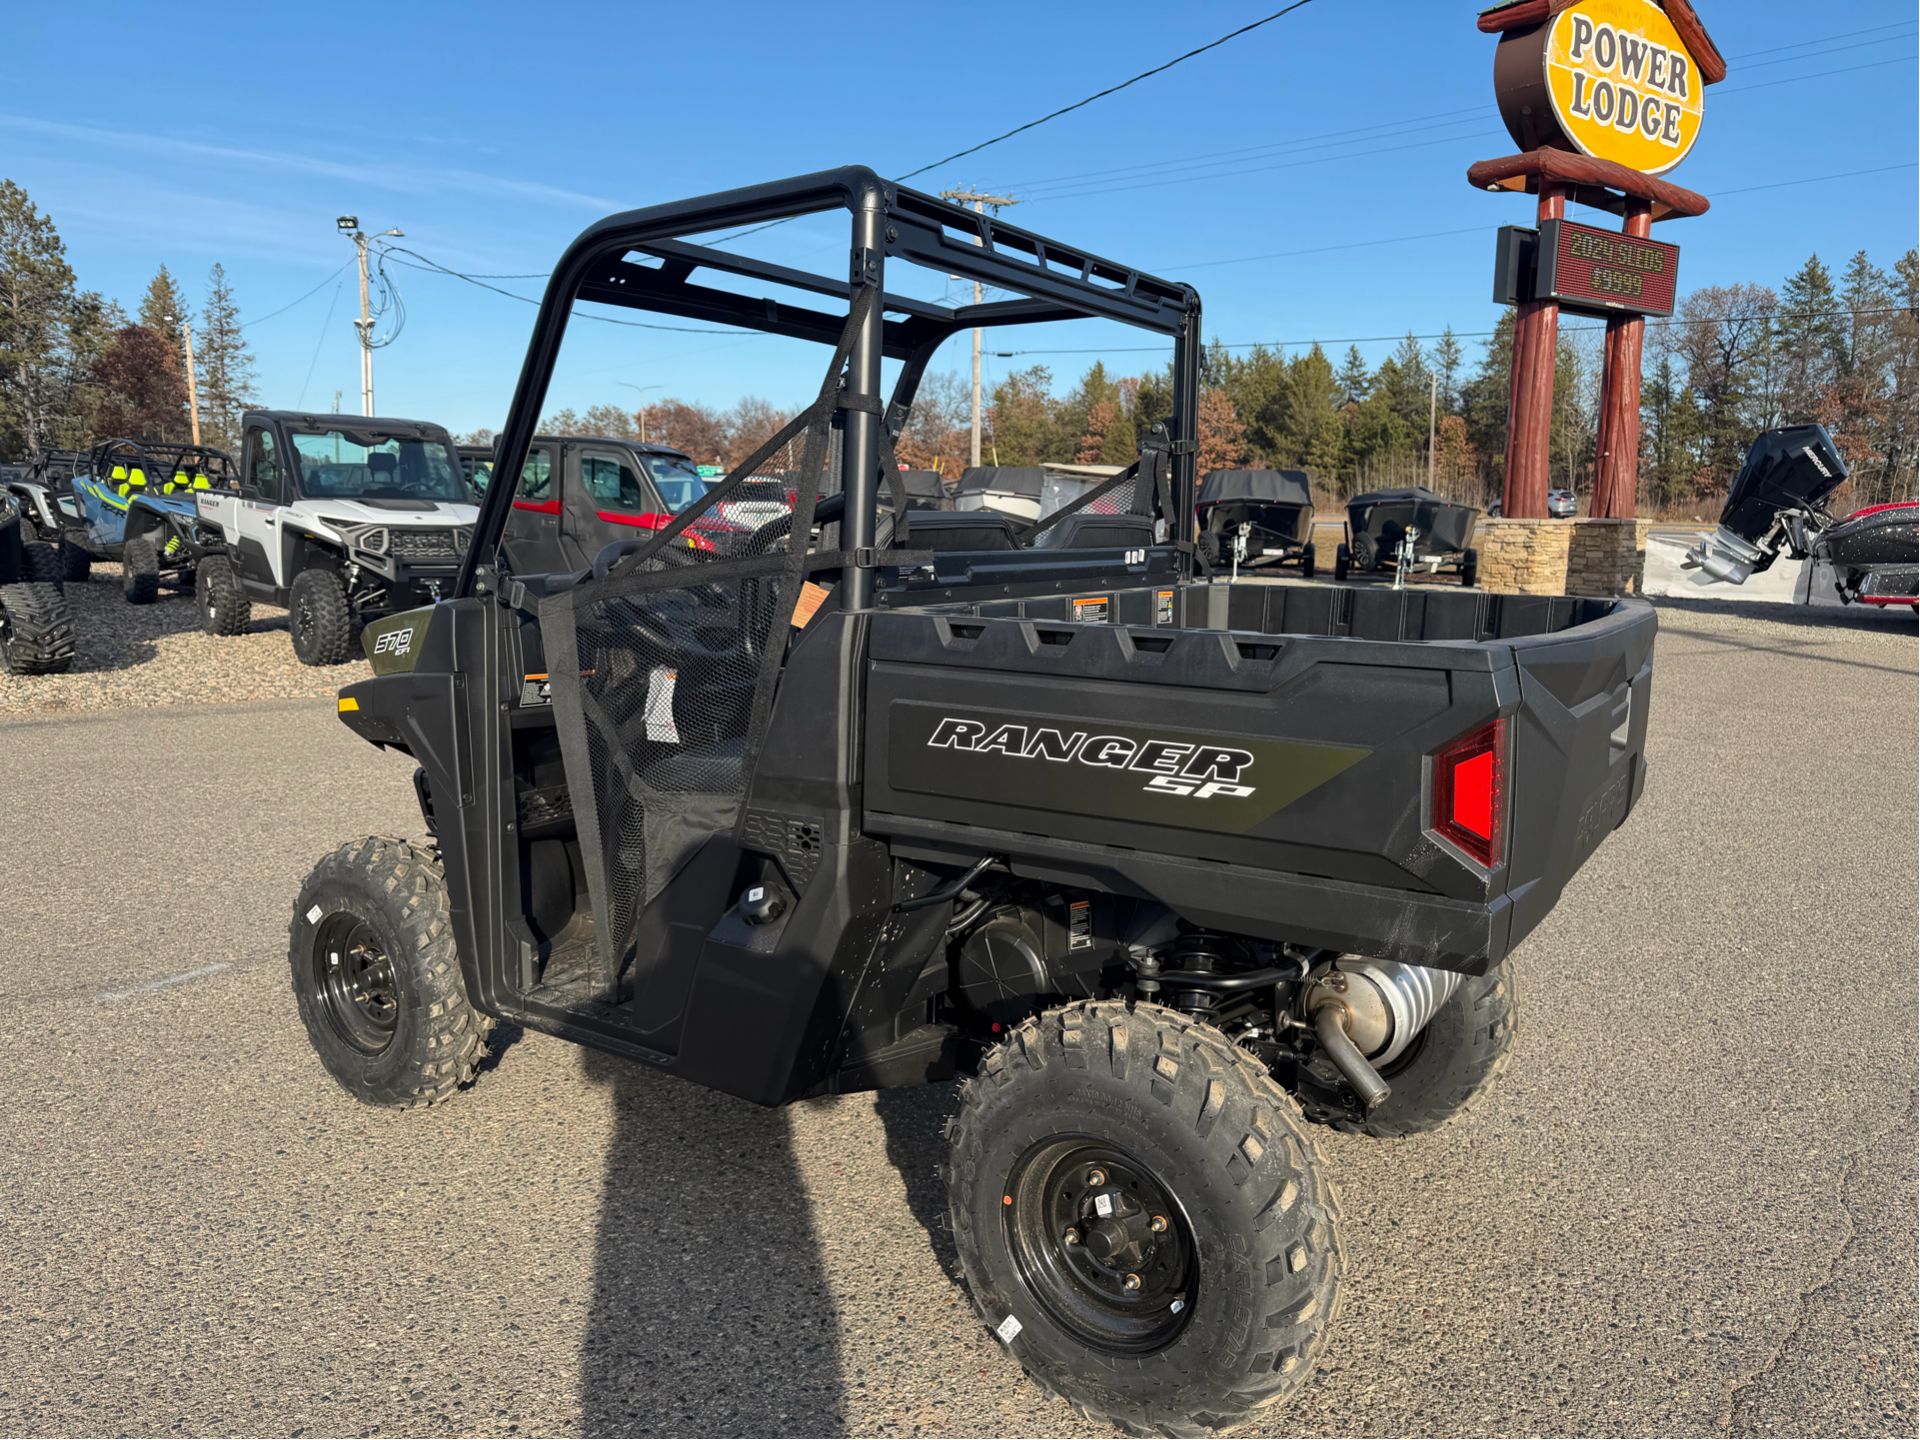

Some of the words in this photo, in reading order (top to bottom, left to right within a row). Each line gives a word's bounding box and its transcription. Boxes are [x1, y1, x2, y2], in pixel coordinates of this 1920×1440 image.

[1571, 16, 1688, 99] POWER
[1570, 71, 1682, 145] LODGE
[1570, 232, 1614, 262] 2024
[1618, 242, 1665, 273] SLEDS
[1591, 266, 1642, 296] $9999
[1802, 446, 1833, 478] MERCURY
[374, 628, 414, 654] 570
[928, 717, 1255, 783] RANGER
[1143, 775, 1257, 799] SP
